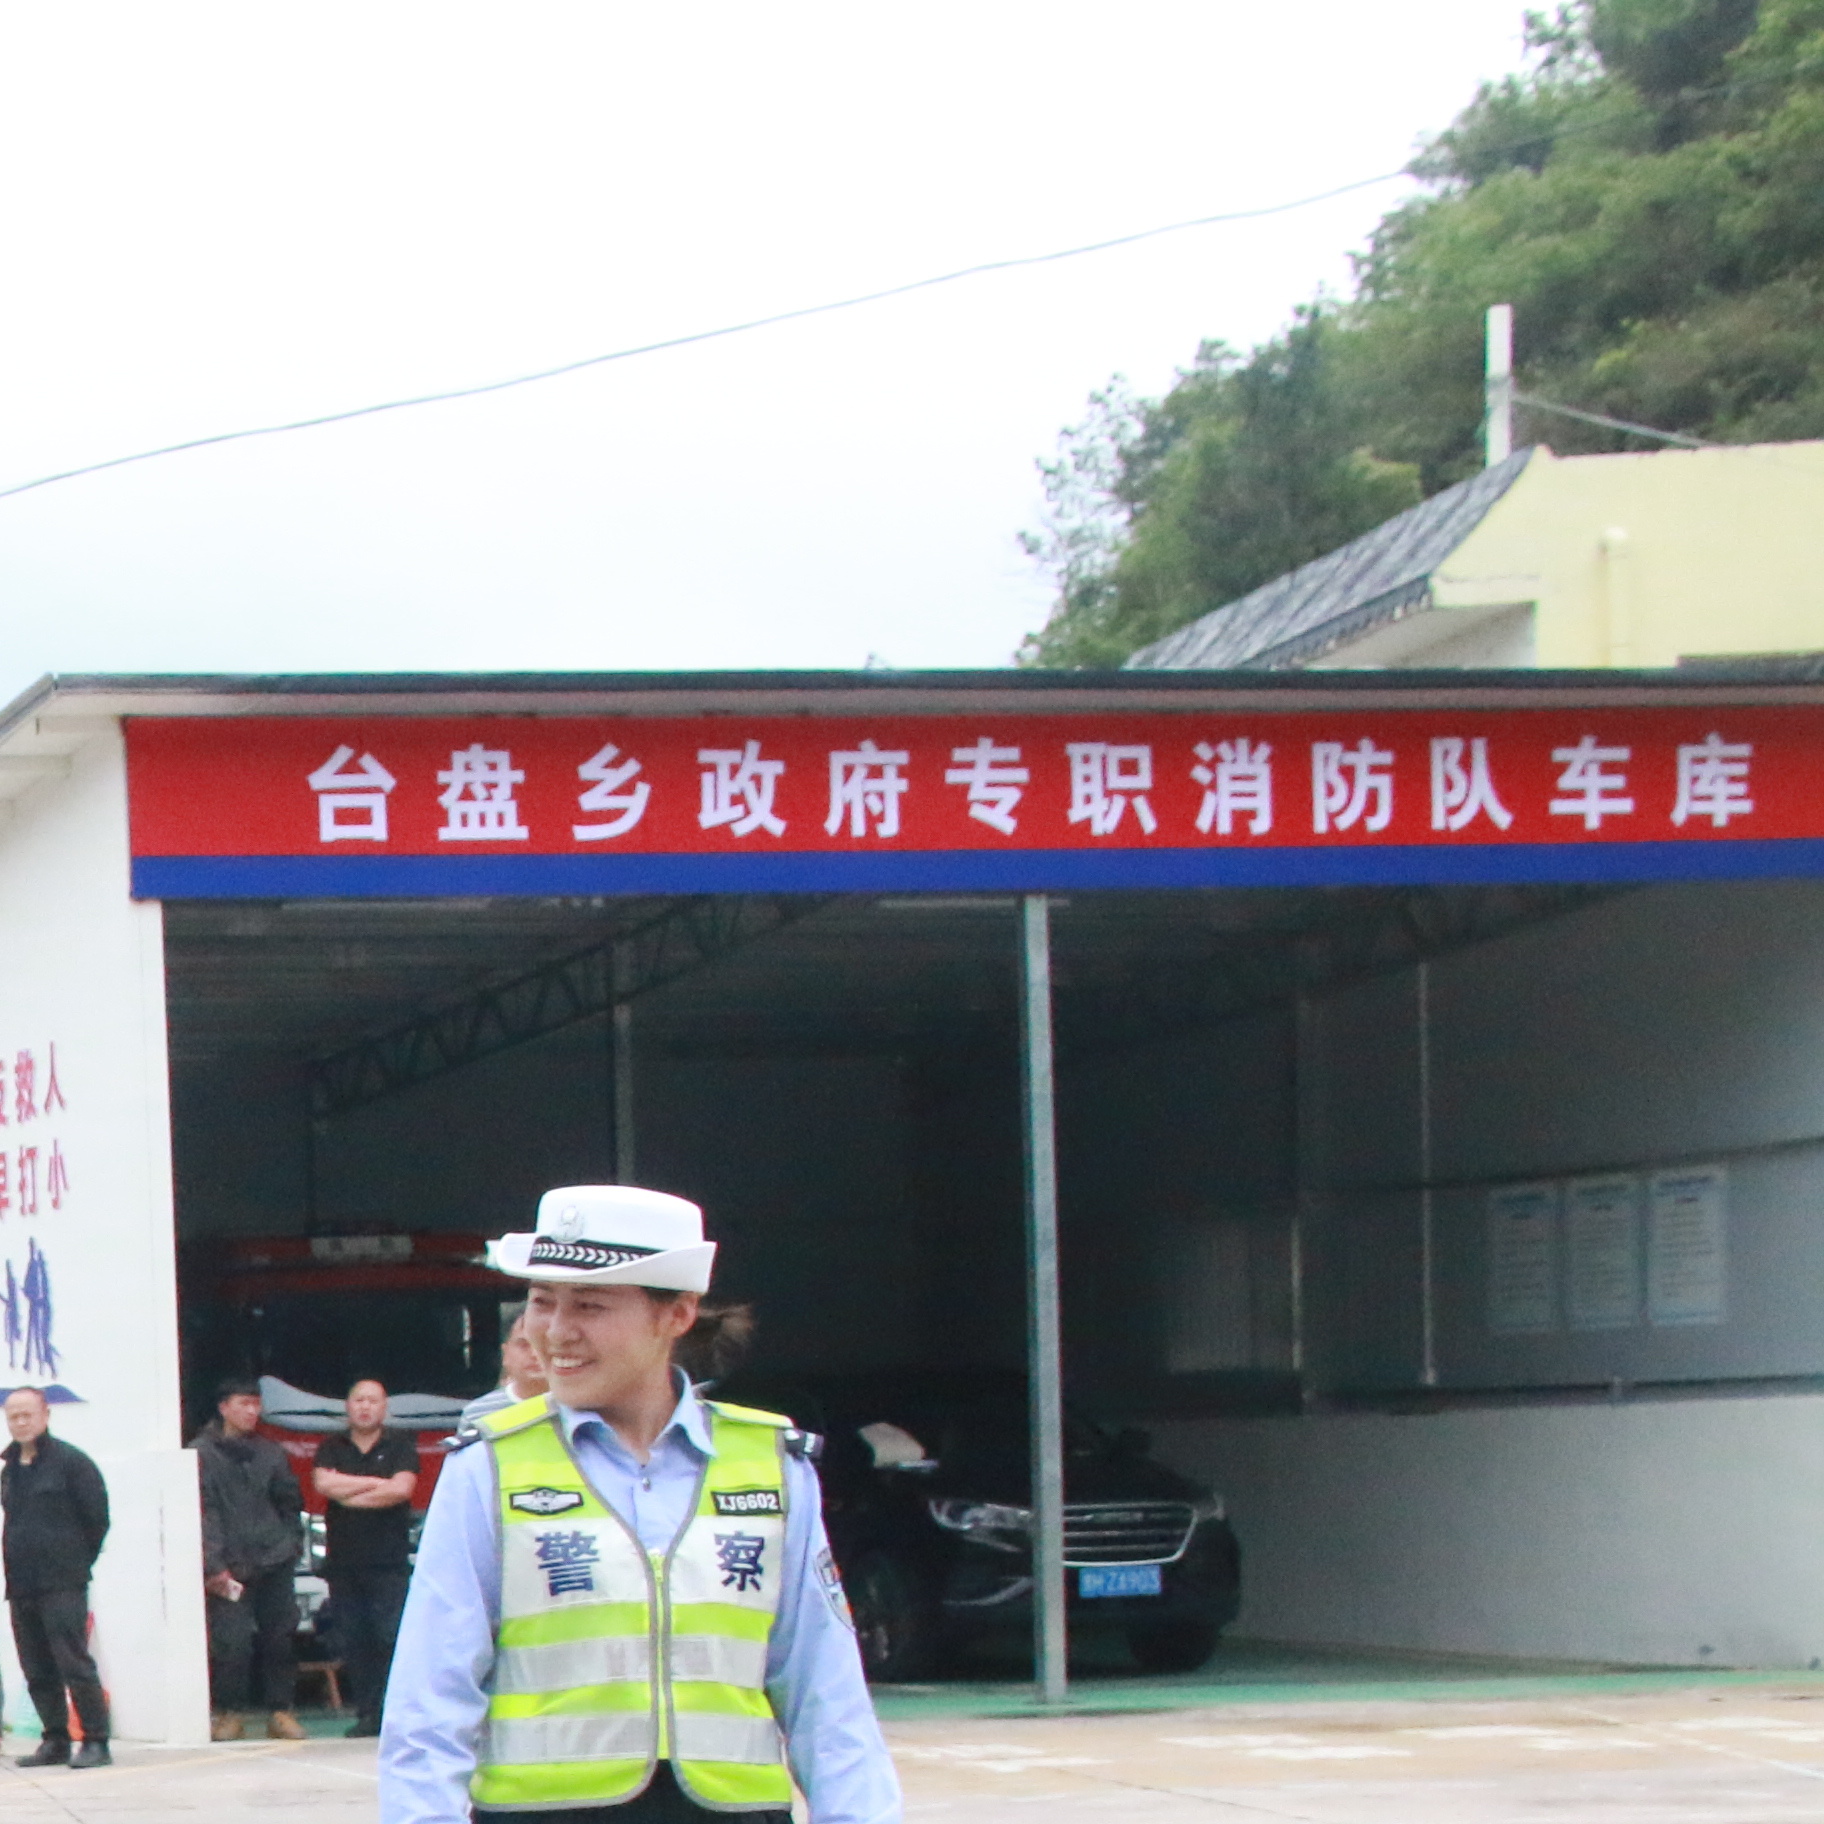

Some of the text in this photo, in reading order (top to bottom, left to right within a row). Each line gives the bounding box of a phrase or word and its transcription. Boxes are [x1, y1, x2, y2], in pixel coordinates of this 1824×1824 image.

[307, 733, 1756, 841] 台盘乡政府专职消防队车库
[534, 1530, 765, 1597] 警 察
